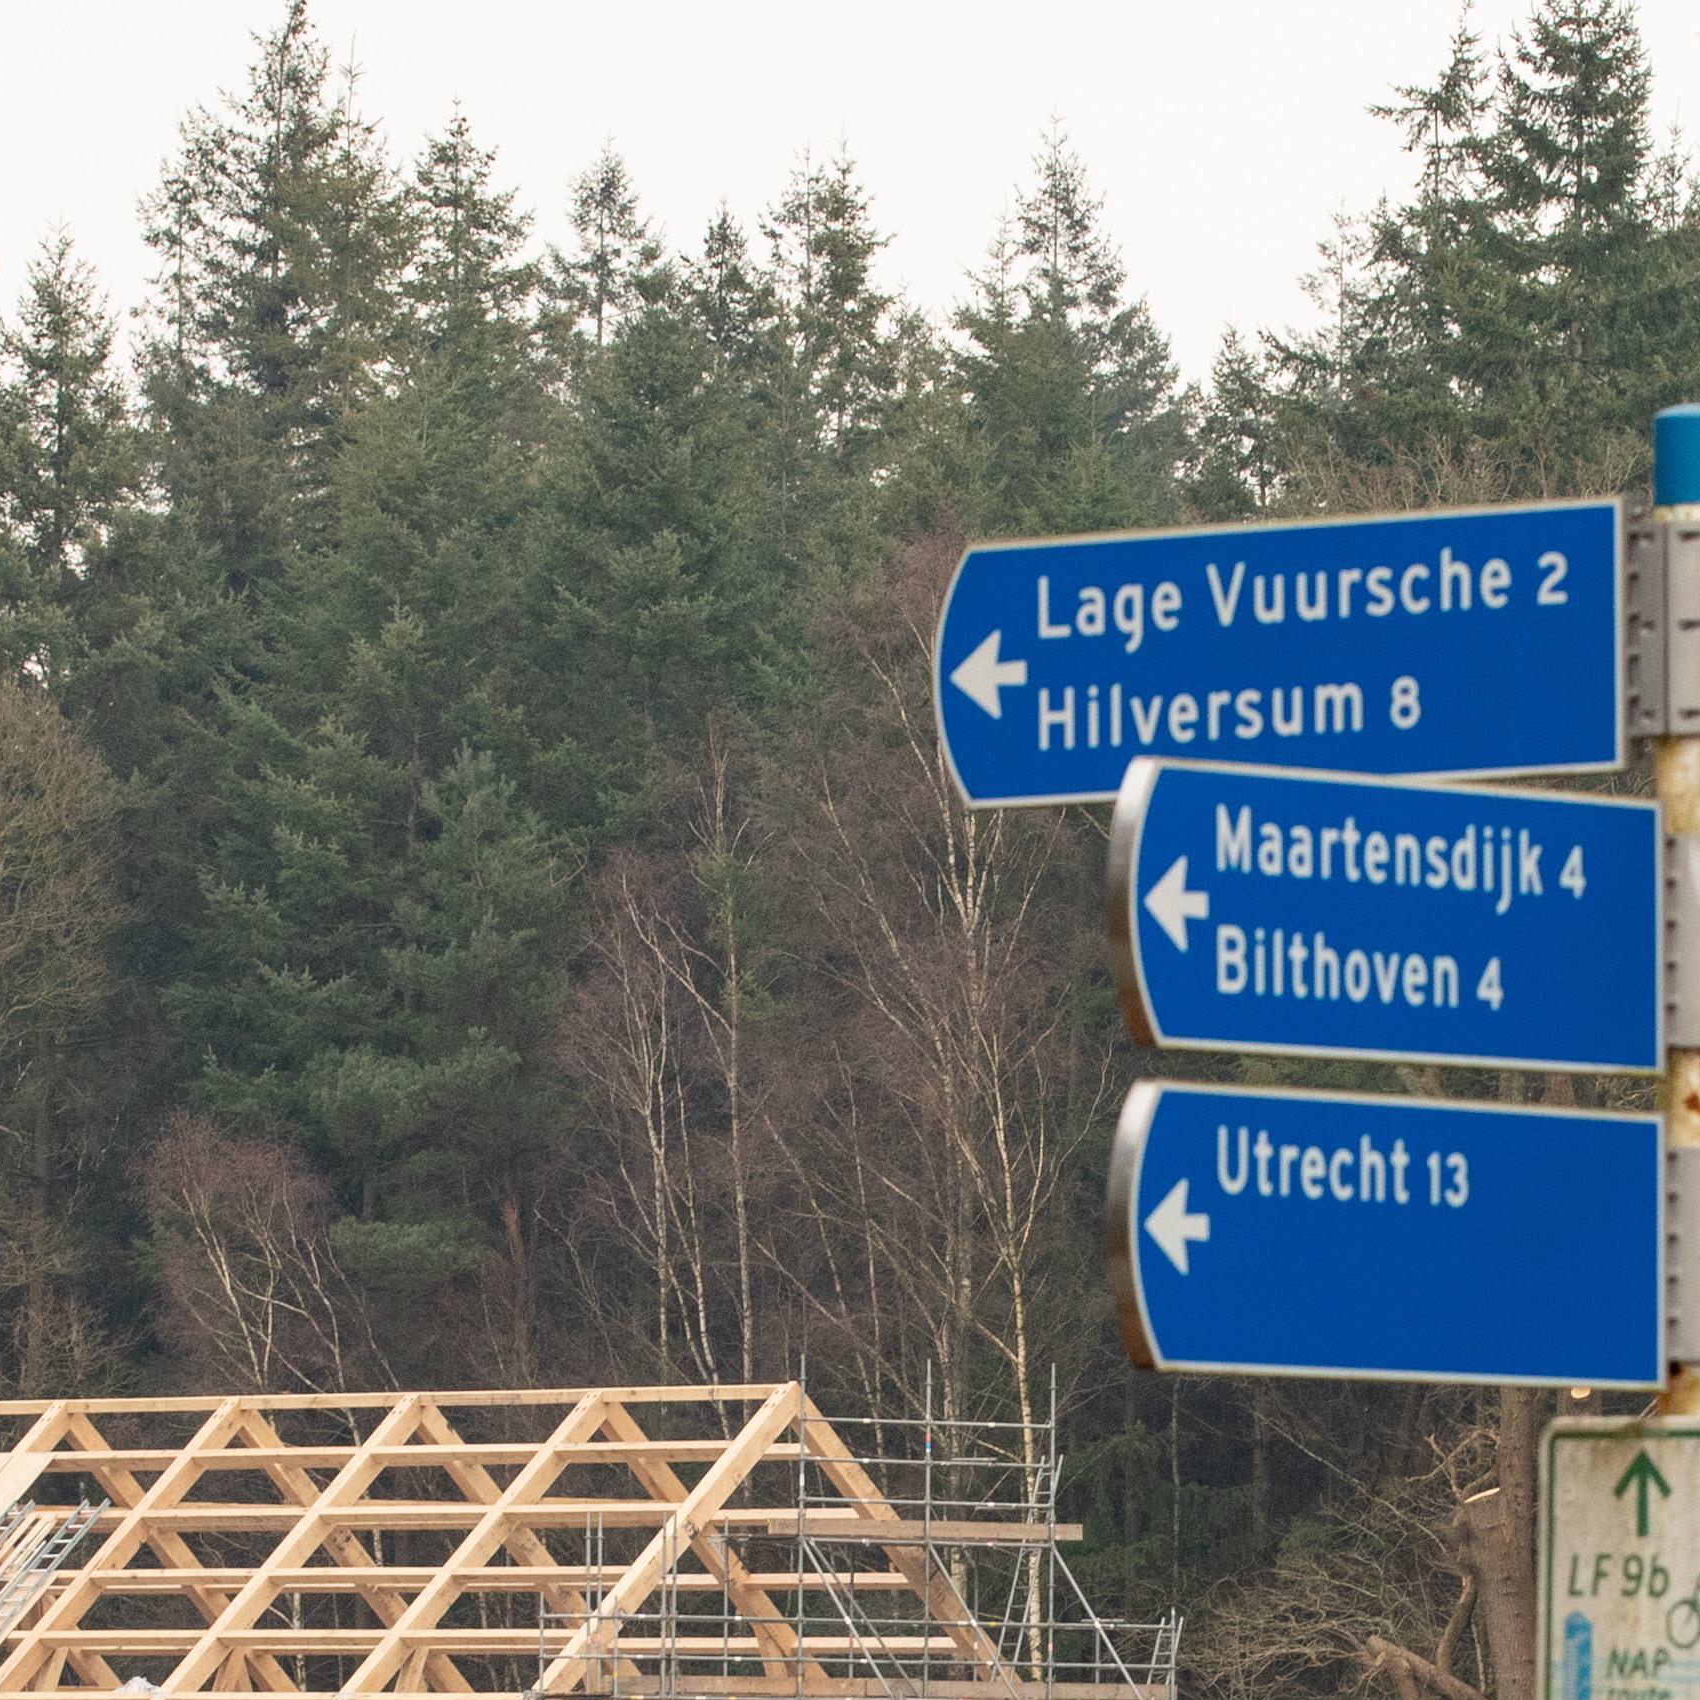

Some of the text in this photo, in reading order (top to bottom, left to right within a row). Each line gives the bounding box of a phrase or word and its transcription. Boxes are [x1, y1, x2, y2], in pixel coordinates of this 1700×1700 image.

[1038, 547, 1568, 653] Lage Vuursche 2
[1038, 676, 1421, 750] Hilversum 8
[1216, 803, 1586, 913] Maartensdijk 4
[1217, 924, 1504, 1009] Bilthoven 4
[1217, 1126, 1468, 1207] Utrecht 13
[1606, 1648, 1670, 1678] NAP
